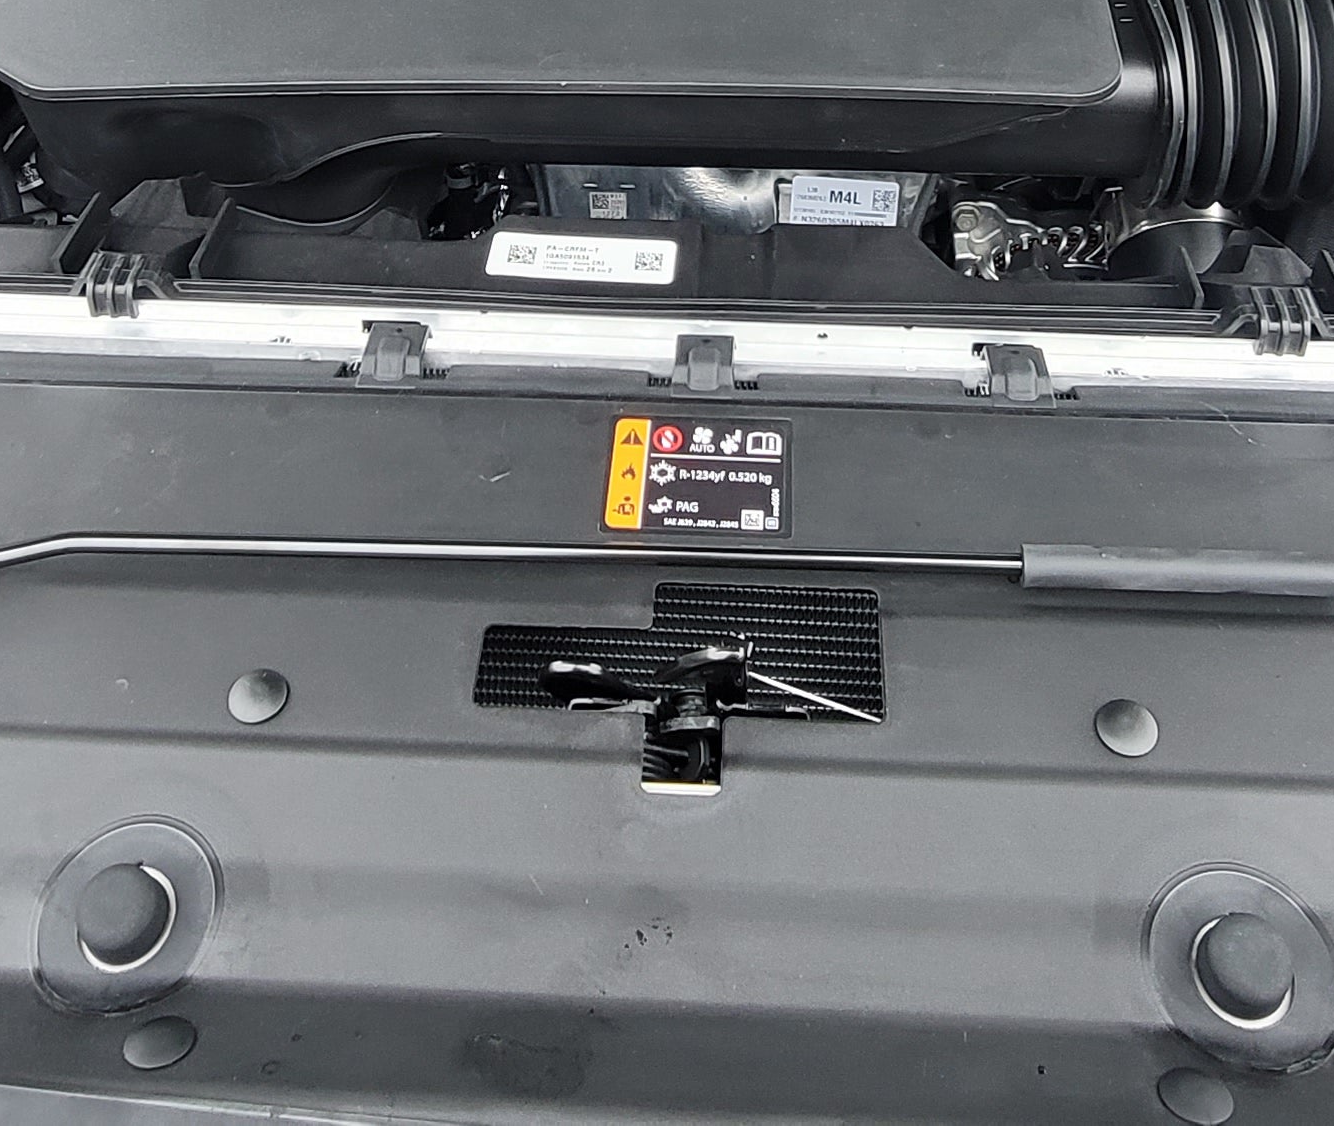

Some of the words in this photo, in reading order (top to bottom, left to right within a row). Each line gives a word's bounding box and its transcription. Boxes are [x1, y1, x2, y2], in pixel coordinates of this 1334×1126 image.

[829, 190, 862, 205] M4L
[689, 443, 715, 454] AUTO
[679, 468, 726, 484] R-1234yf
[728, 471, 758, 483] 0.520
[759, 472, 773, 486] kg
[675, 500, 699, 513] PAG
